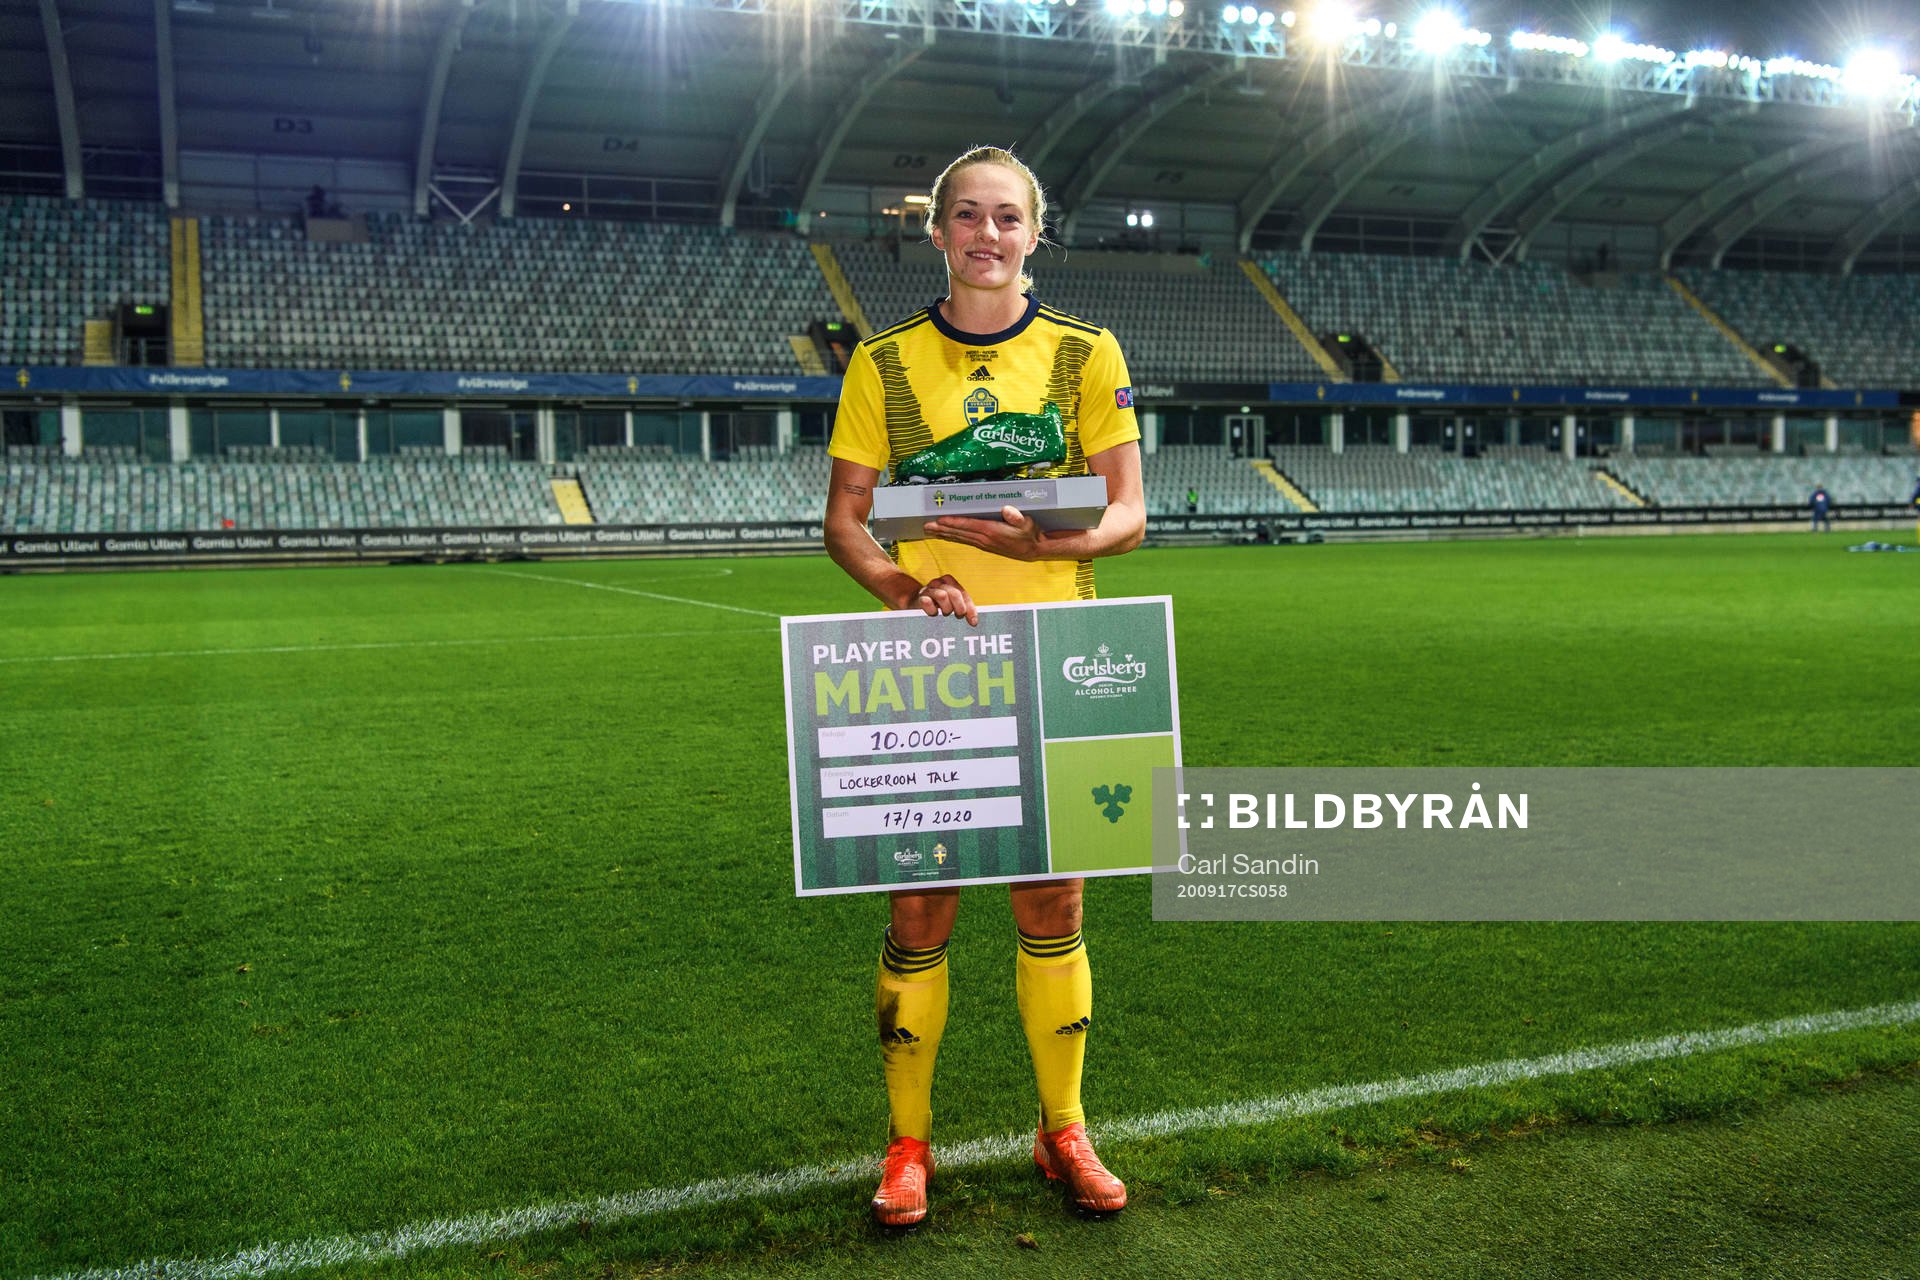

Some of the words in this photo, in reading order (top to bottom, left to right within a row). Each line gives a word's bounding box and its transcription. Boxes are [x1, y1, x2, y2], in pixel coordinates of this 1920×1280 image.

[273, 117, 313, 133] D3
[973, 424, 1046, 453] Carlsberg
[998, 491, 1023, 499] match
[813, 639, 912, 664] PLAYER
[920, 637, 956, 659] OF
[963, 634, 1013, 656] THE
[1063, 656, 1147, 683] Carlsberg
[814, 660, 1016, 716] MATCH
[1074, 687, 1115, 696] ALCOHOL
[870, 729, 961, 751] 10.000:-
[839, 772, 917, 790] LOCKERROOM
[926, 771, 960, 784] TALK
[883, 808, 924, 829] 17/9
[932, 810, 972, 824] 2020
